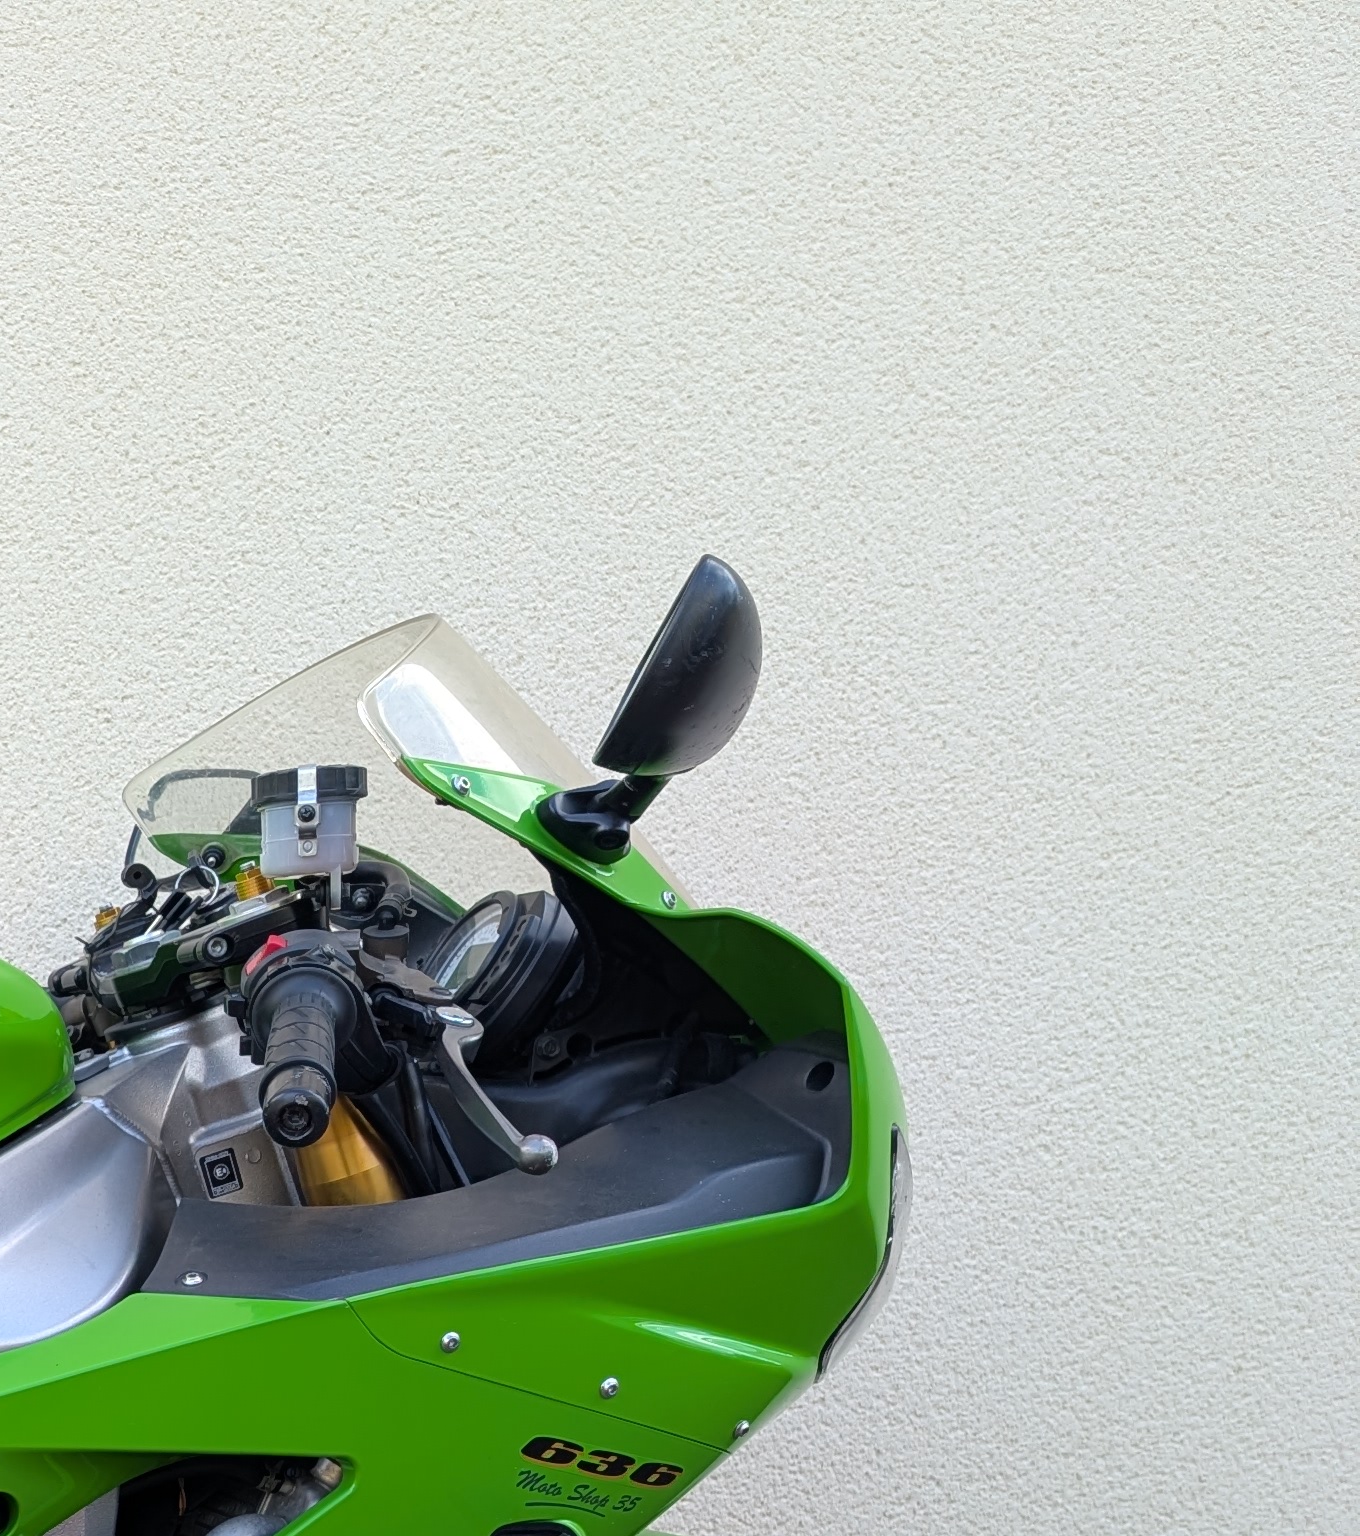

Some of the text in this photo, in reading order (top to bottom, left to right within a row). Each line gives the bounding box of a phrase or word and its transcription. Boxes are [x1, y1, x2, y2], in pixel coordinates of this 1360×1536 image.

[520, 1436, 684, 1488] 636
[516, 1470, 643, 1513] Moto Shop 35
